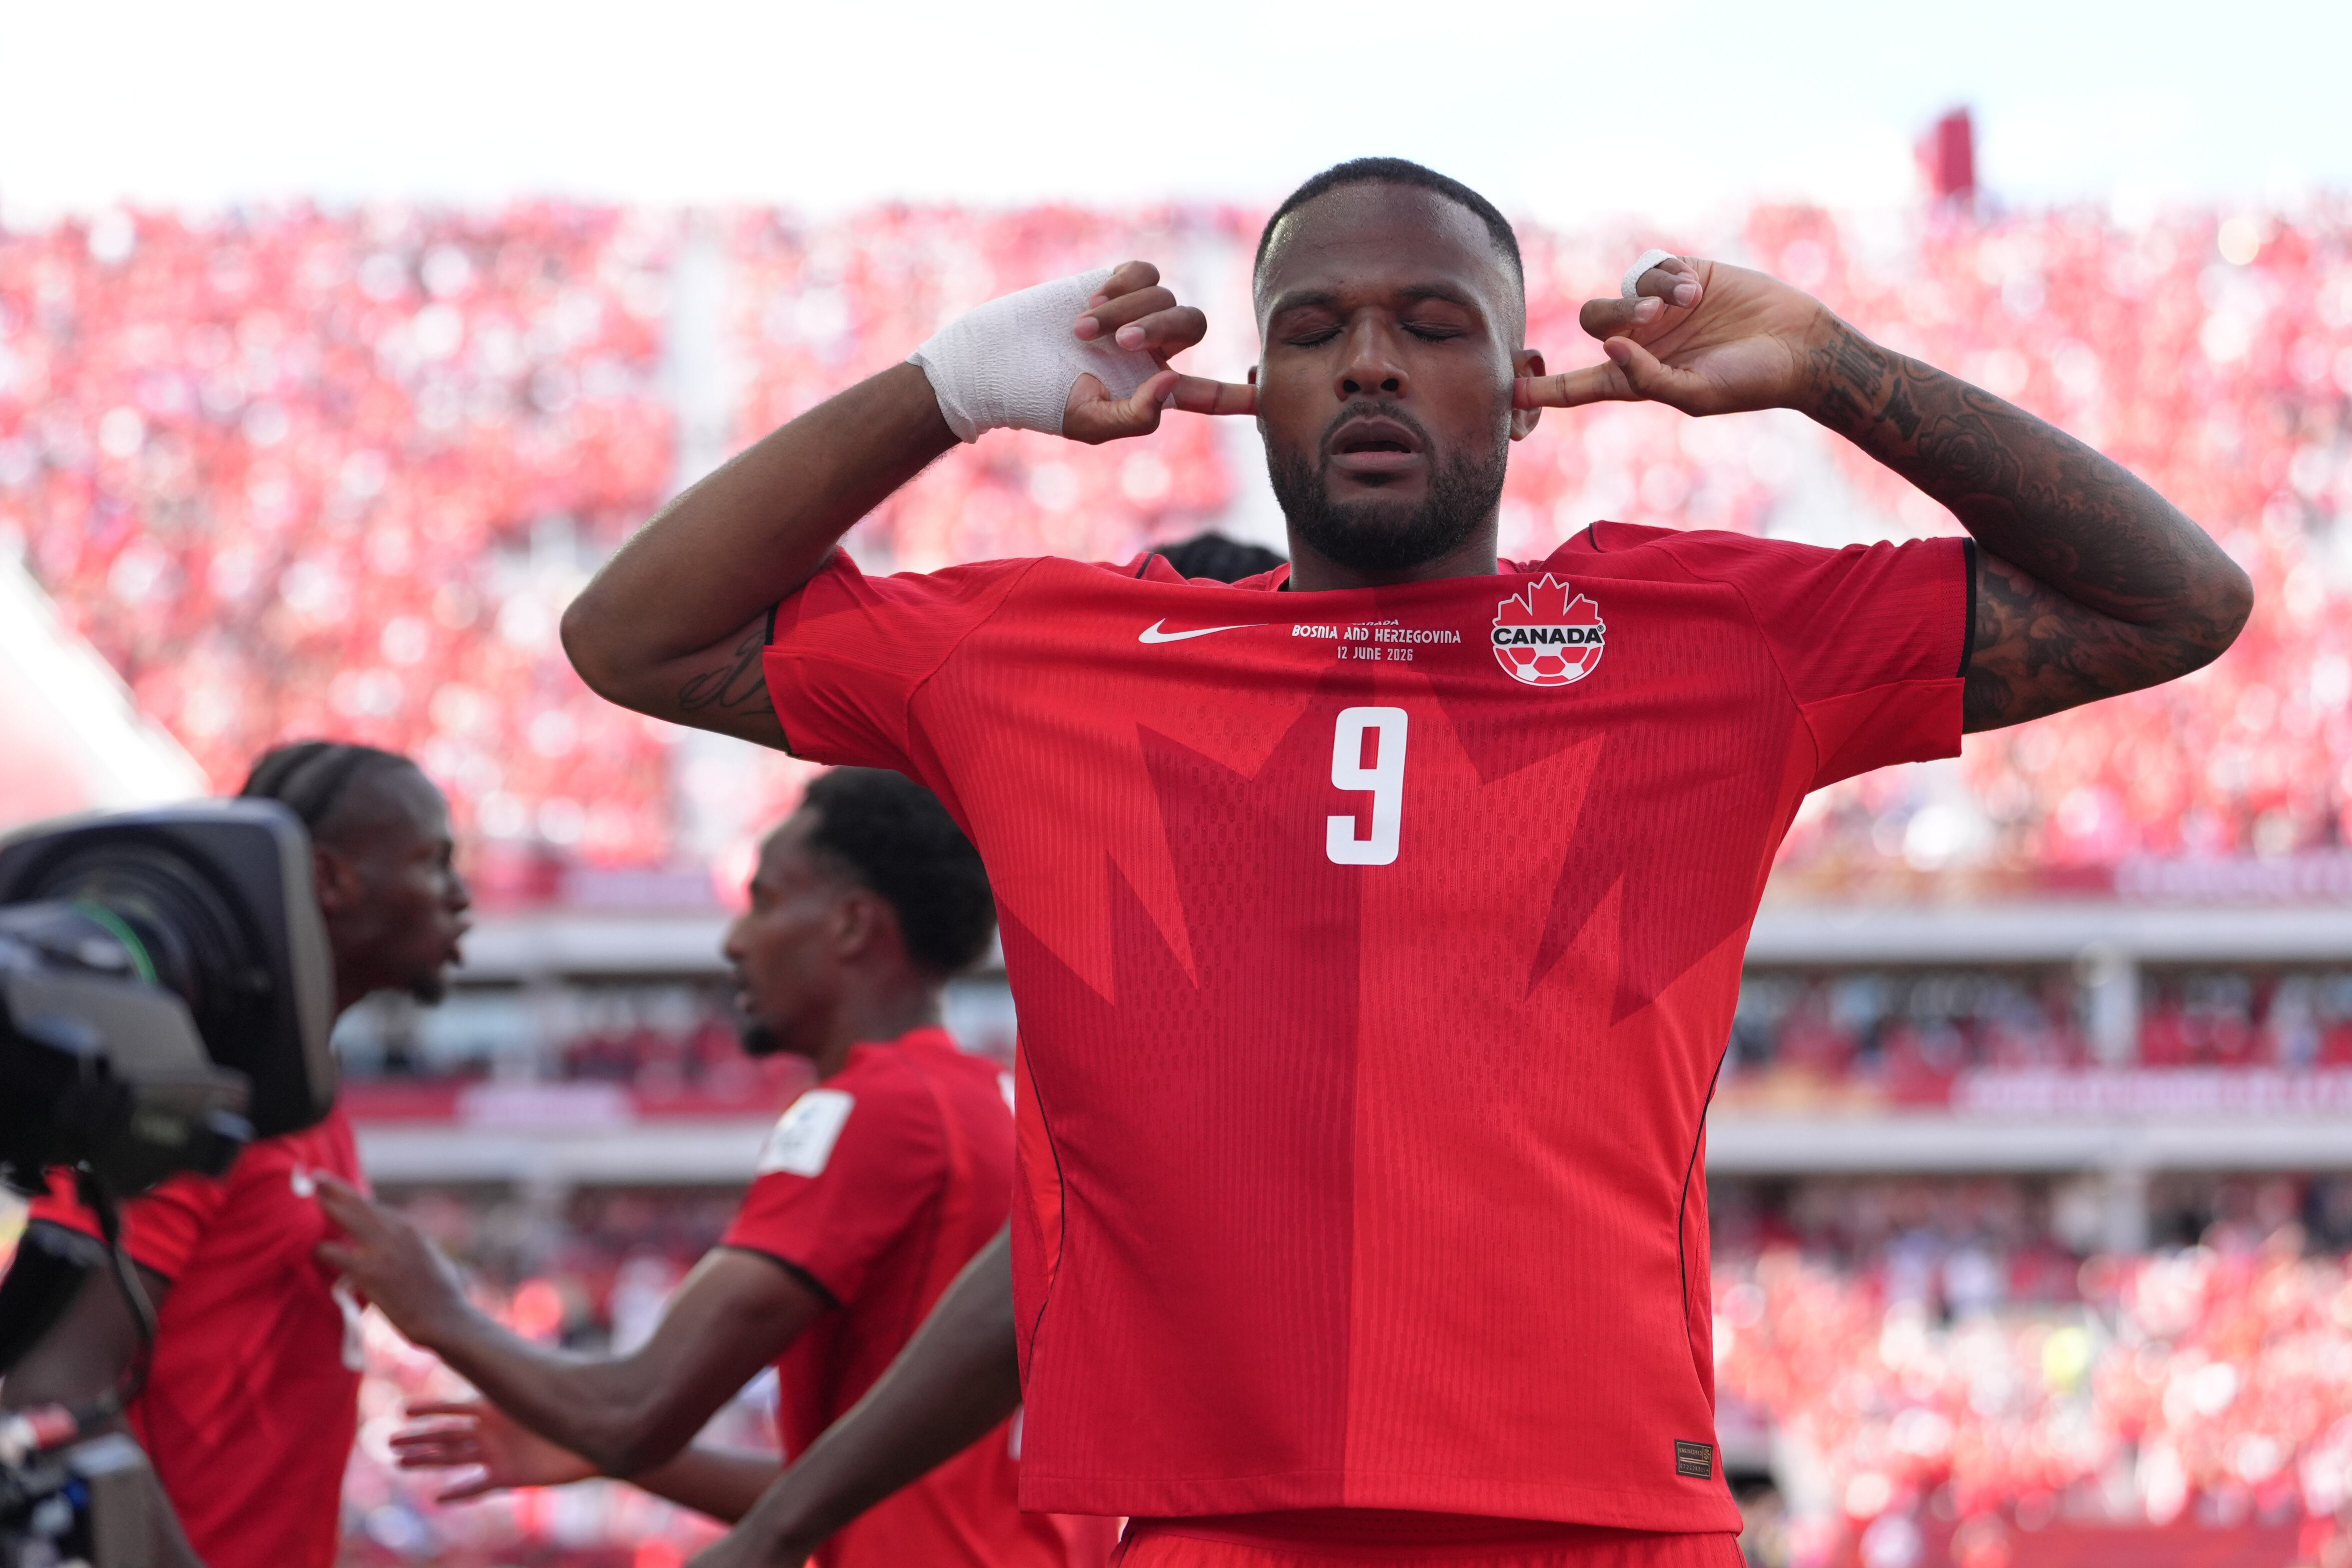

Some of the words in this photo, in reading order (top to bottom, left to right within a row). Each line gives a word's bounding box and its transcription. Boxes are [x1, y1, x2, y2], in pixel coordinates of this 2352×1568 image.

[1292, 624, 1338, 639] BOSNIA
[1344, 627, 1369, 641] AND
[1375, 628, 1461, 644] HERZEGOVINA
[1493, 628, 1603, 645] CANADA
[1337, 646, 1348, 659] 12
[1353, 647, 1381, 660] JUNE
[1387, 648, 1413, 661] 2026
[1326, 706, 1408, 866] 9
